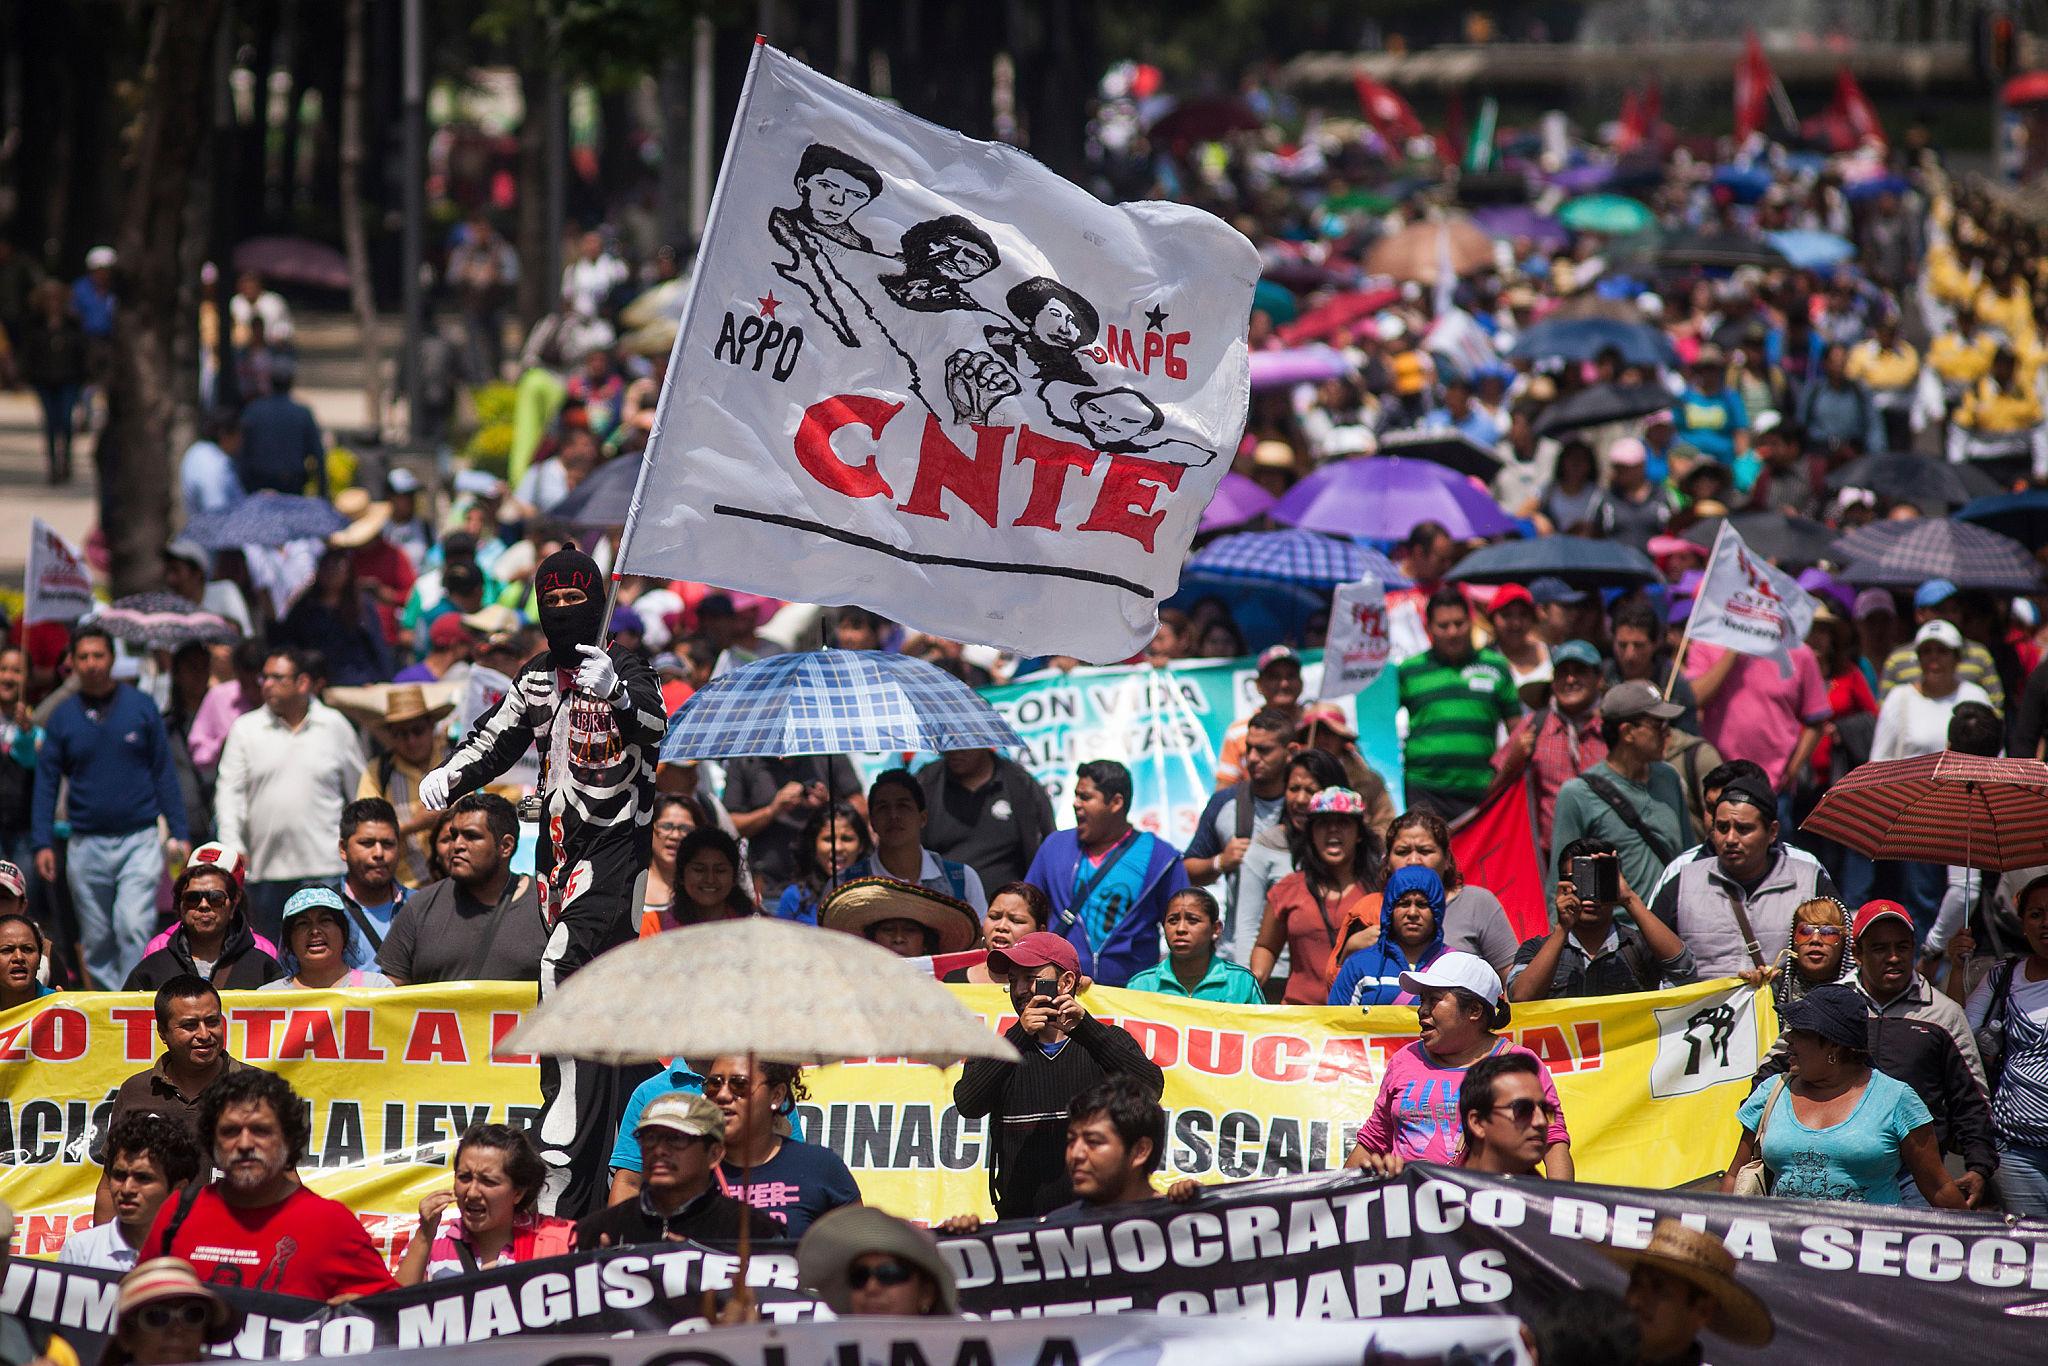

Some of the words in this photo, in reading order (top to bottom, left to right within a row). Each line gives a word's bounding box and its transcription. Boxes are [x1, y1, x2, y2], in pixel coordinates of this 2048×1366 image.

[714, 312, 804, 382] APPO
[794, 394, 1186, 554] CNTE
[112, 1009, 385, 1062] TTAL
[405, 1011, 468, 1064] A
[492, 1012, 541, 1065] L
[797, 1103, 993, 1169] DINAC
[3, 1262, 375, 1361] VIMNTO
[398, 1250, 799, 1349] MAGISTER
[933, 1179, 1526, 1290] DEMOCRATICO
[1550, 1196, 1656, 1250] DE
